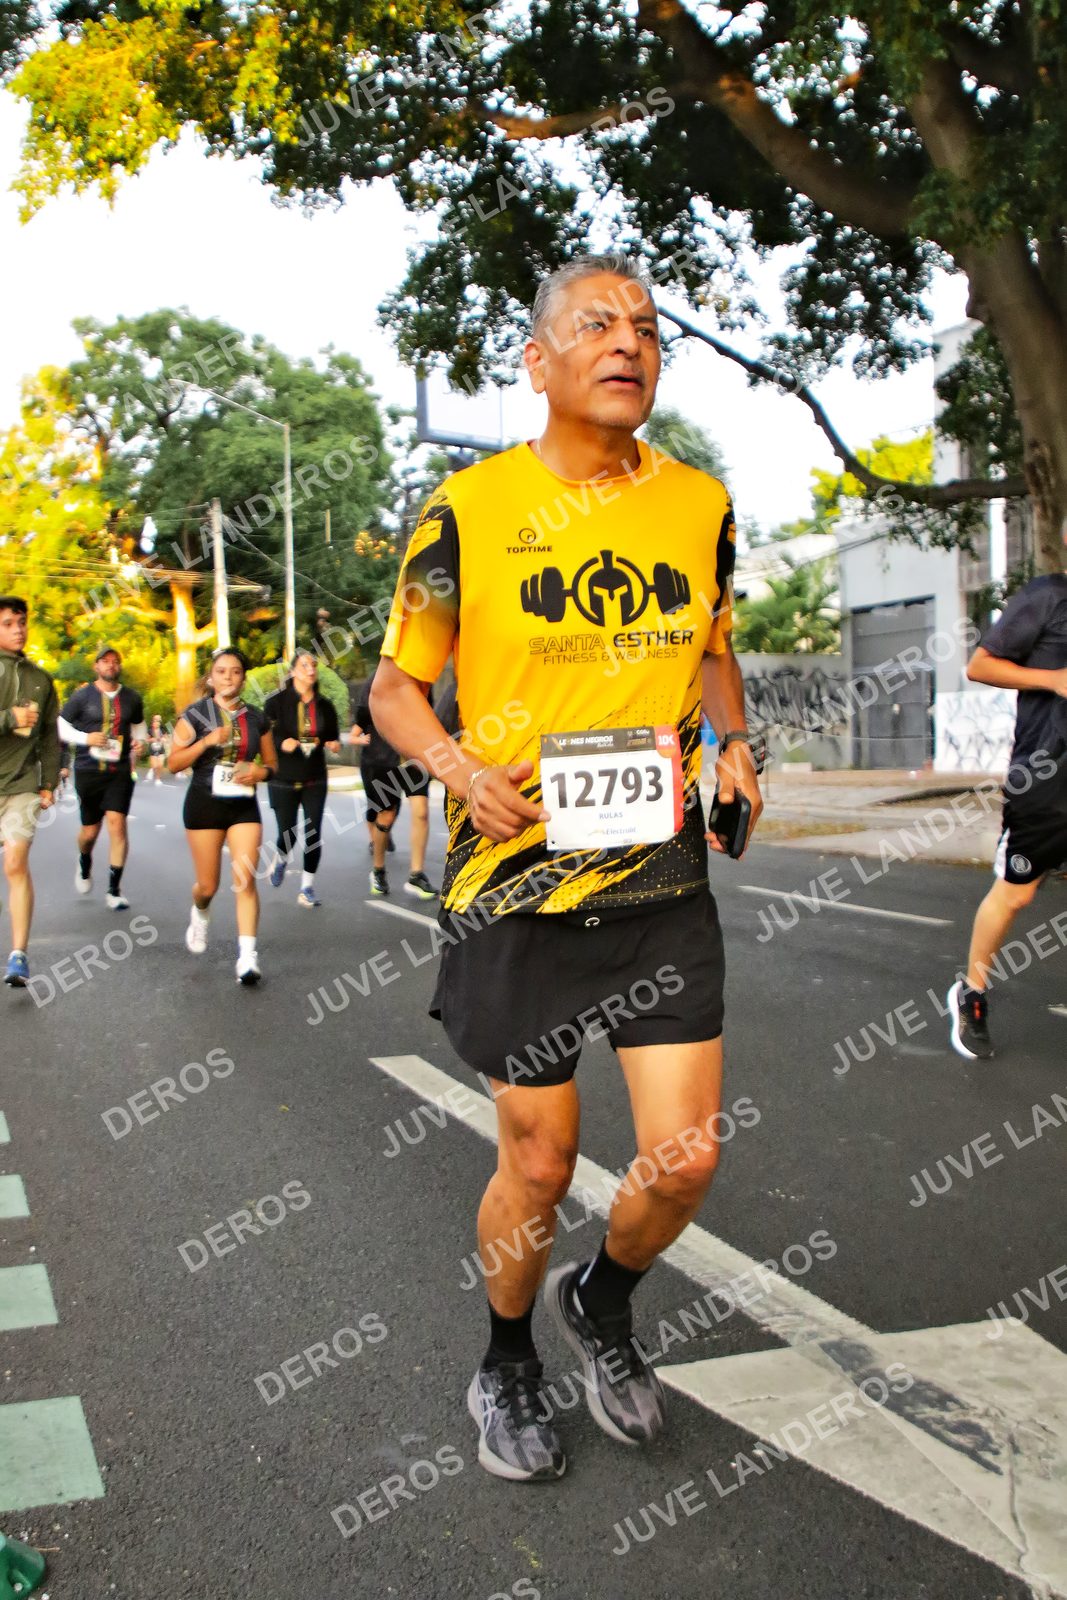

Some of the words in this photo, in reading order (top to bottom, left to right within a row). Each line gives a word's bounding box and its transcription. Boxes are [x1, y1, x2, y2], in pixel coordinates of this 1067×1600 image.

[506, 545, 552, 554] TOPTIME
[529, 633, 605, 655] SANTA
[613, 630, 694, 648] ESTHER
[543, 652, 598, 665] FITNESS
[615, 648, 679, 660] WELLNESS
[550, 765, 664, 809] 12793
[599, 811, 623, 820] RULAS
